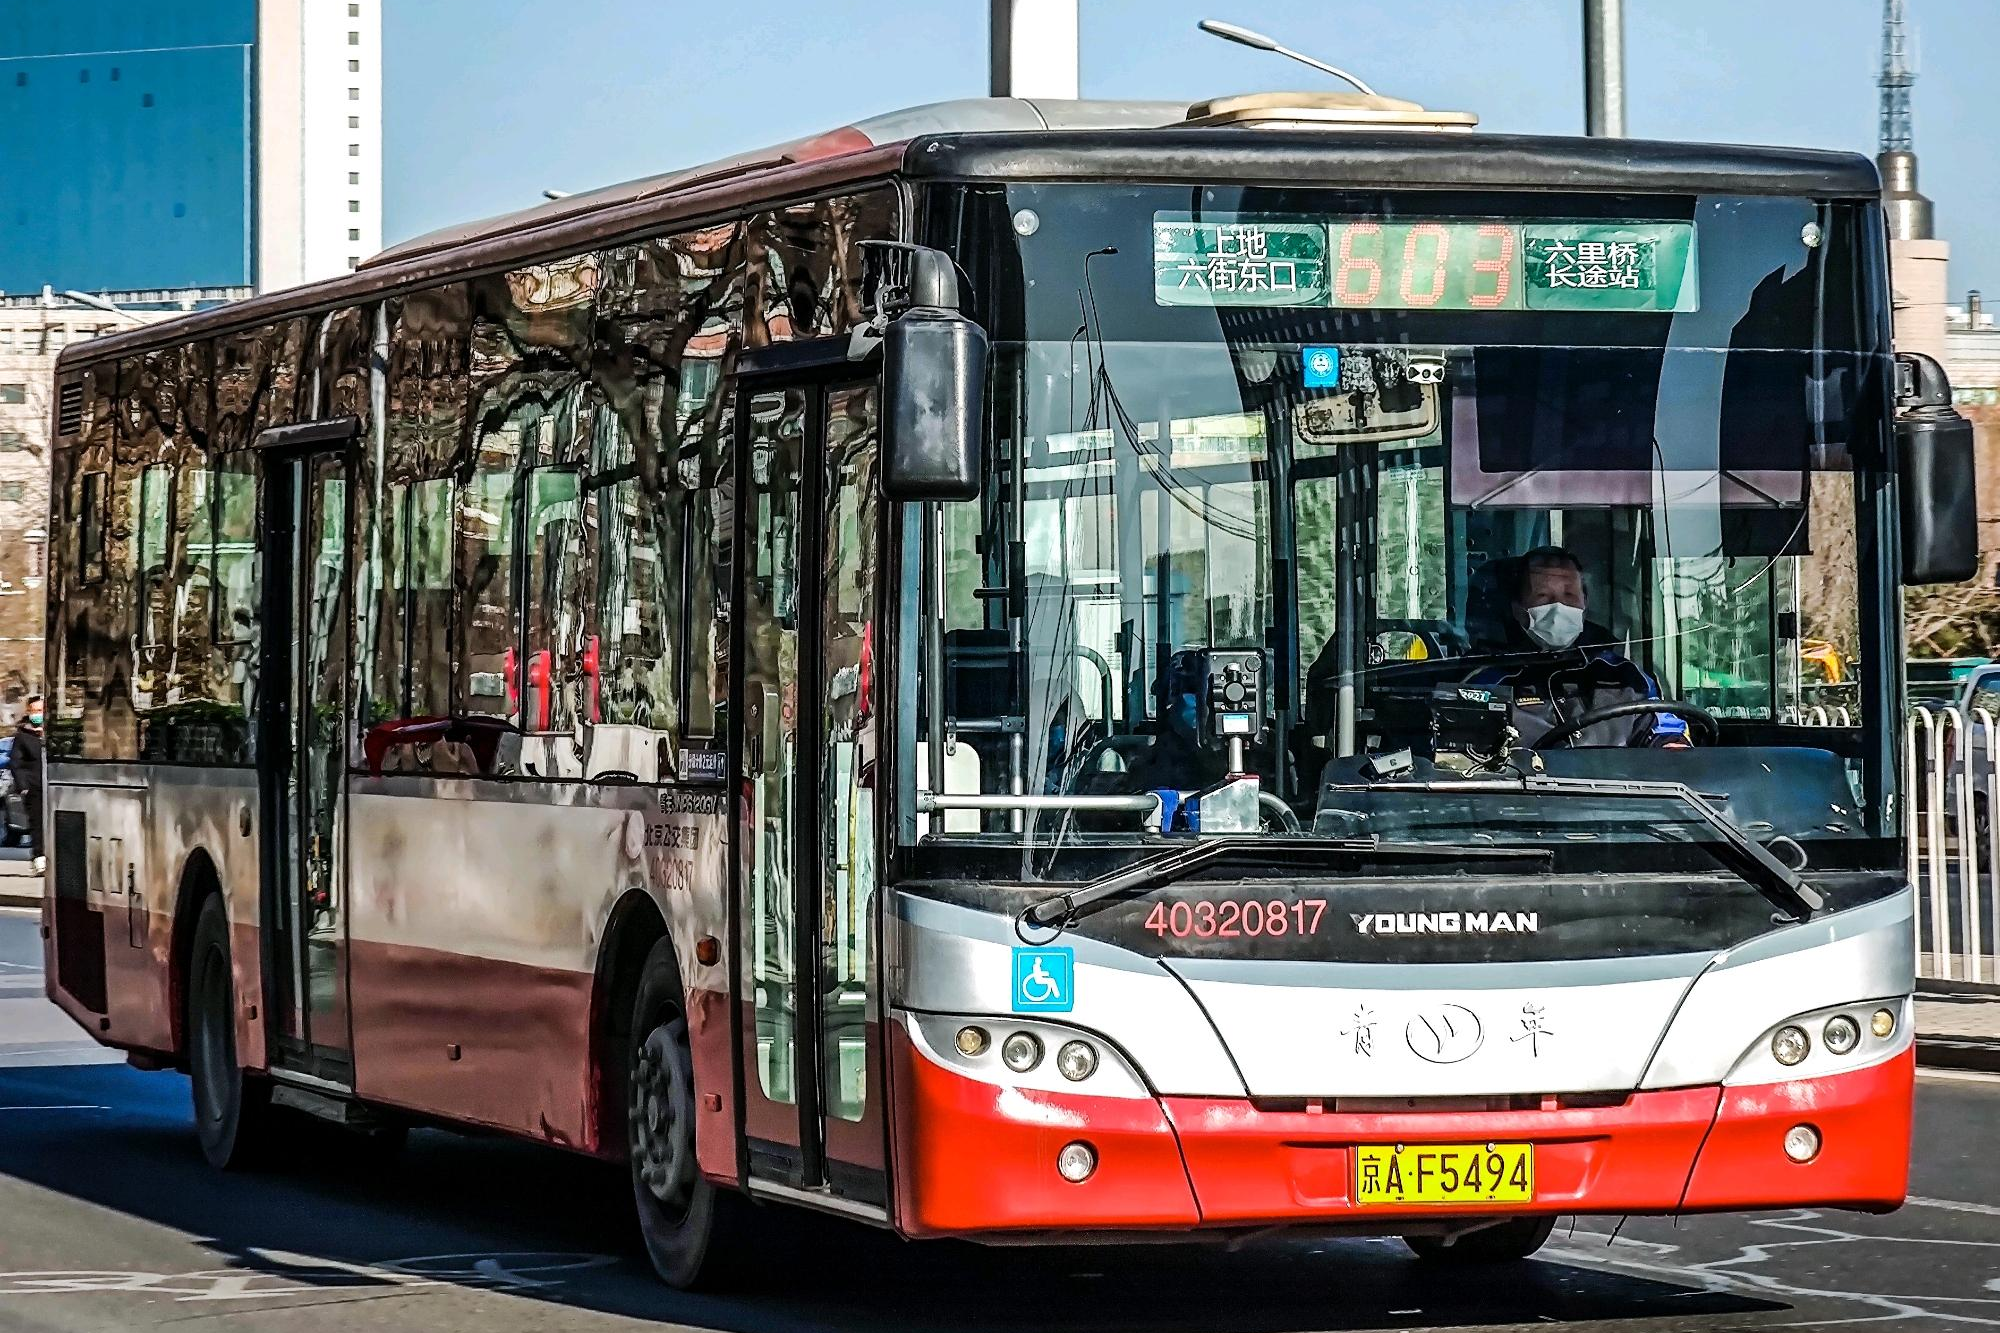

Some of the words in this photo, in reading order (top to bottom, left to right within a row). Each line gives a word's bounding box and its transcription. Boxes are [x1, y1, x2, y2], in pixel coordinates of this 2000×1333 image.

[1206, 226, 1268, 259] 上地
[1543, 241, 1640, 266] 六里桥
[1177, 259, 1298, 293] 六街东口
[1335, 223, 1514, 306] 603
[1543, 265, 1640, 290] 长途站
[1144, 899, 1328, 937] 40320817
